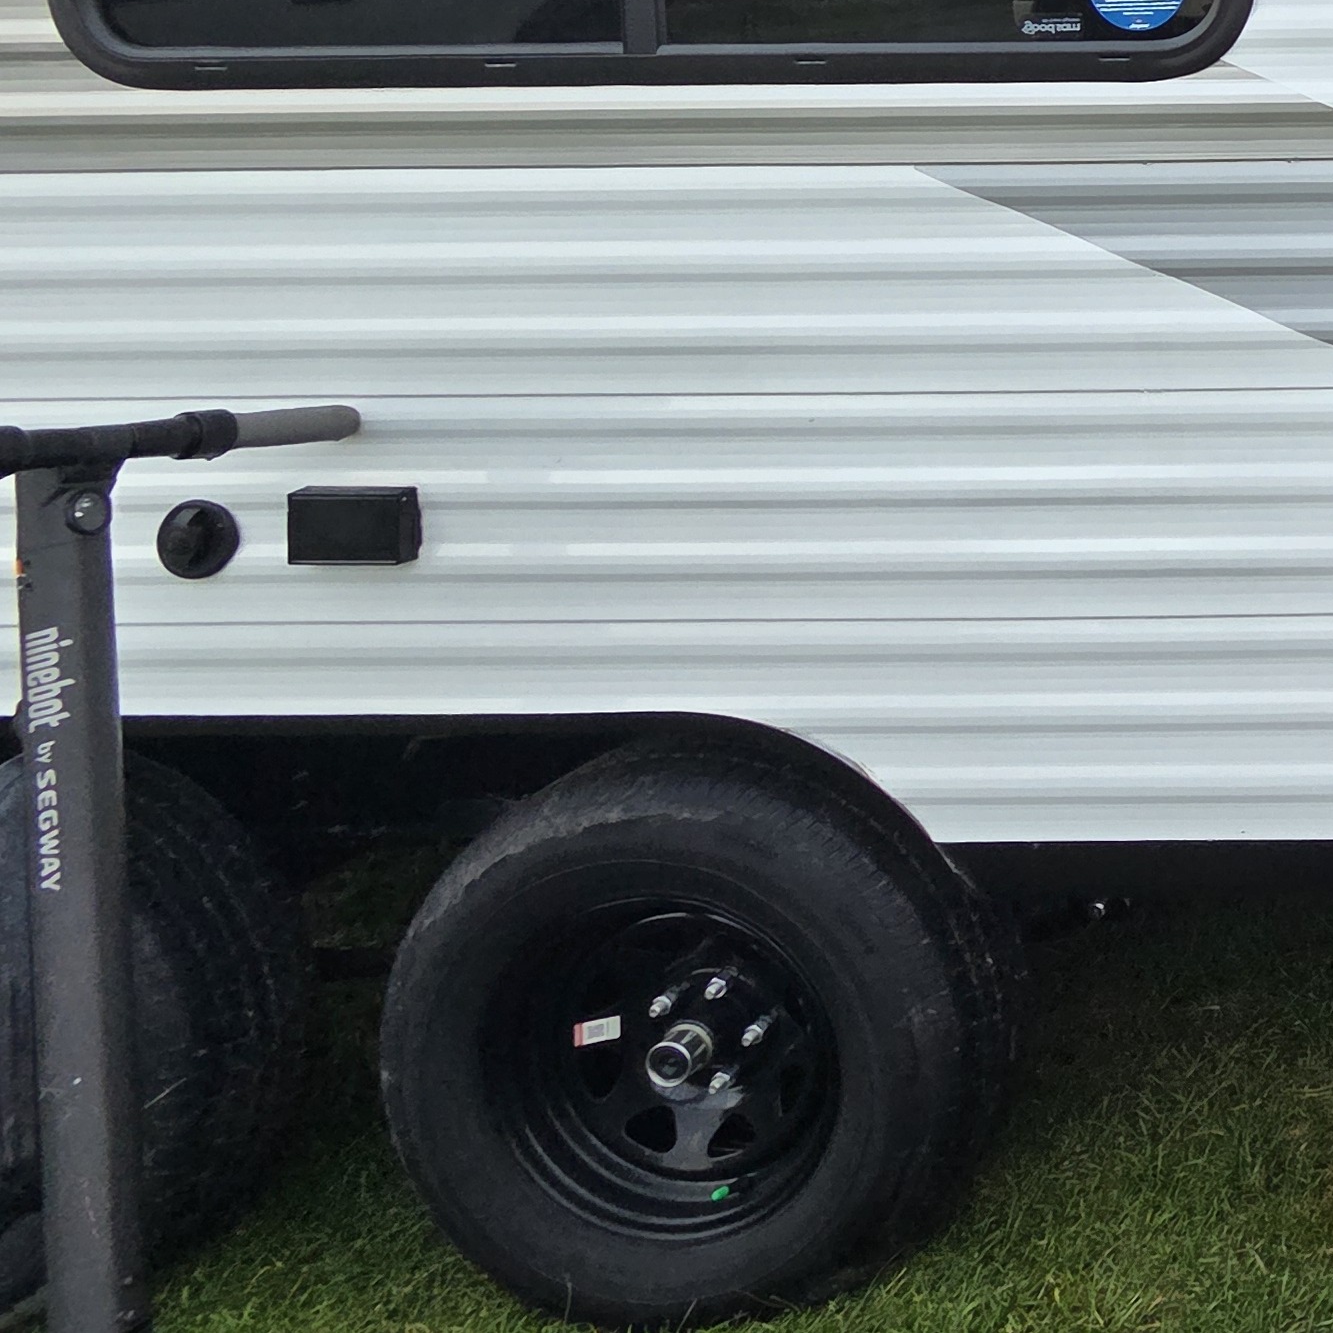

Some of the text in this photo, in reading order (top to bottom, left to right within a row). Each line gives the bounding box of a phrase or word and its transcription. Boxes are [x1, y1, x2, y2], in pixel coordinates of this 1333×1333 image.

[25, 627, 76, 891] ninebot by SEGWAY
